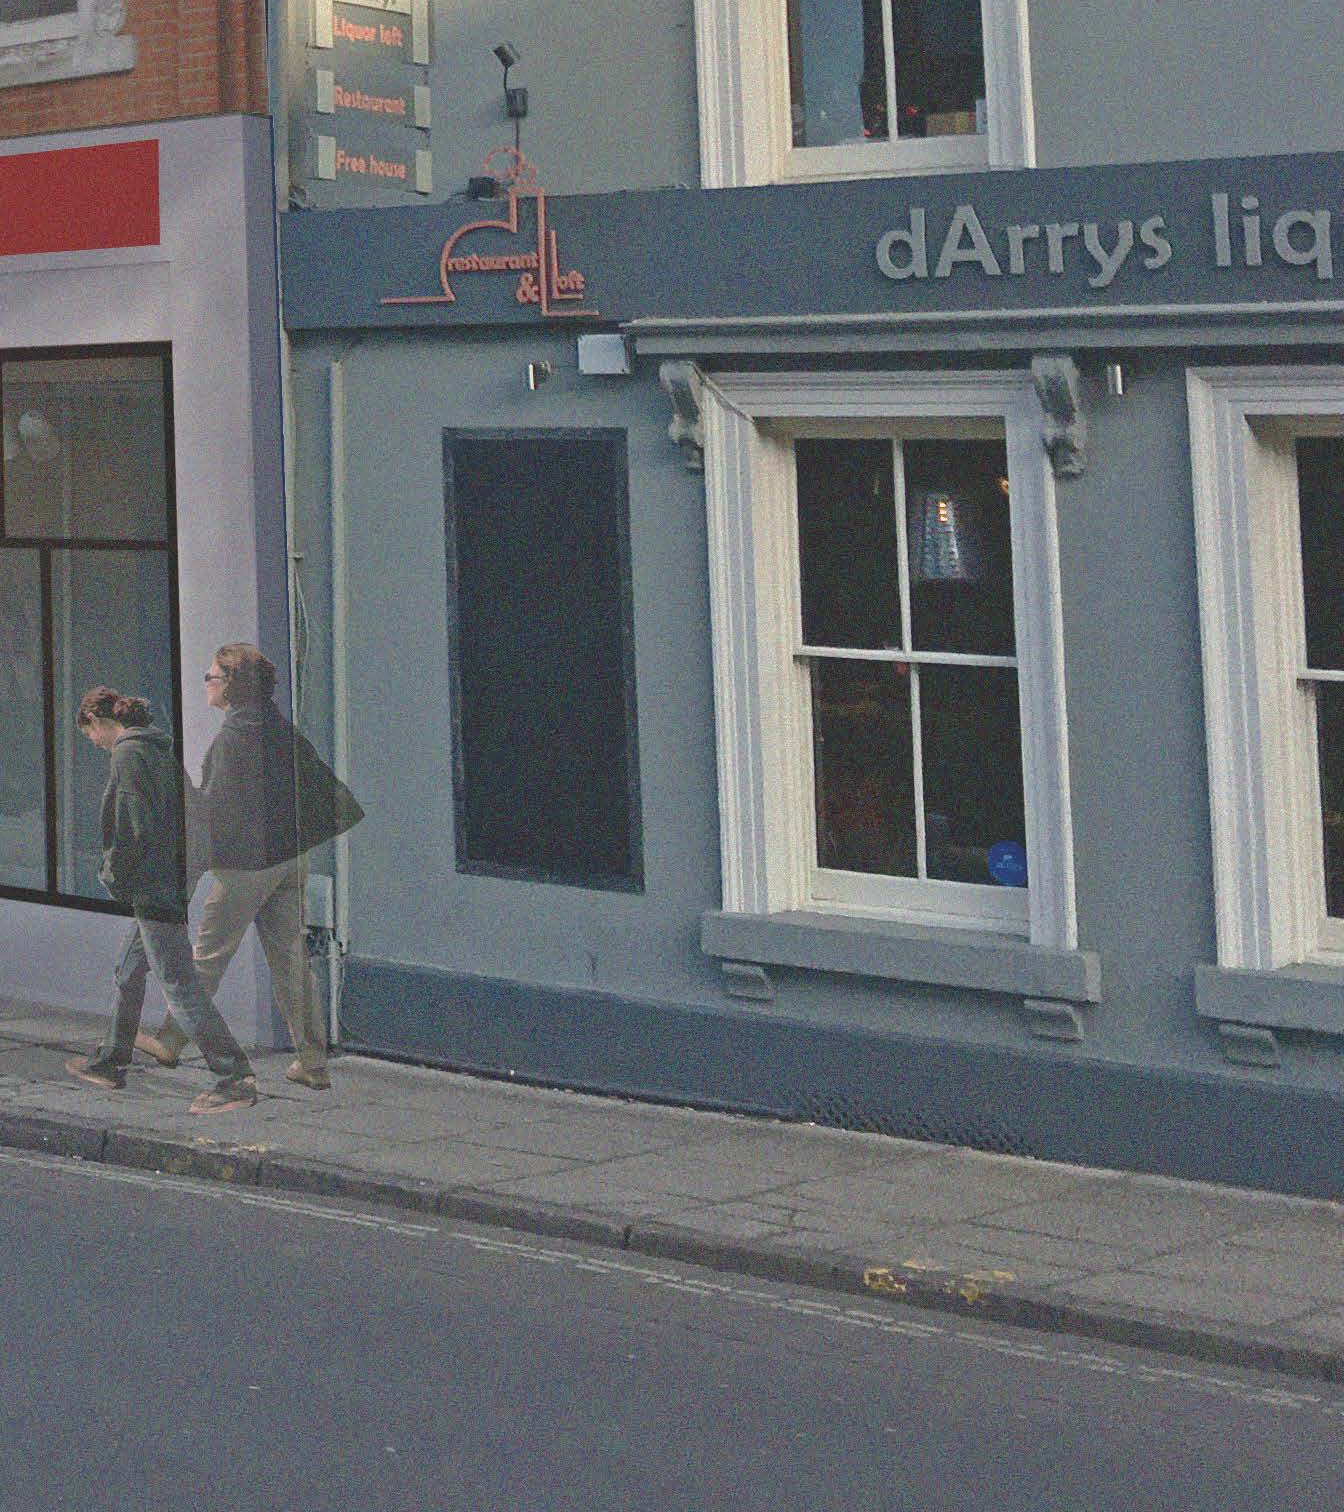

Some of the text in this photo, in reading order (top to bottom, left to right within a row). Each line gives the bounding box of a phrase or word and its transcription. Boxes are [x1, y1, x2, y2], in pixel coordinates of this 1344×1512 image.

[334, 87, 406, 115] Restaurant
[336, 149, 406, 178] Free house
[875, 192, 1333, 288] dArrys liq
[448, 252, 539, 271] restaurant
